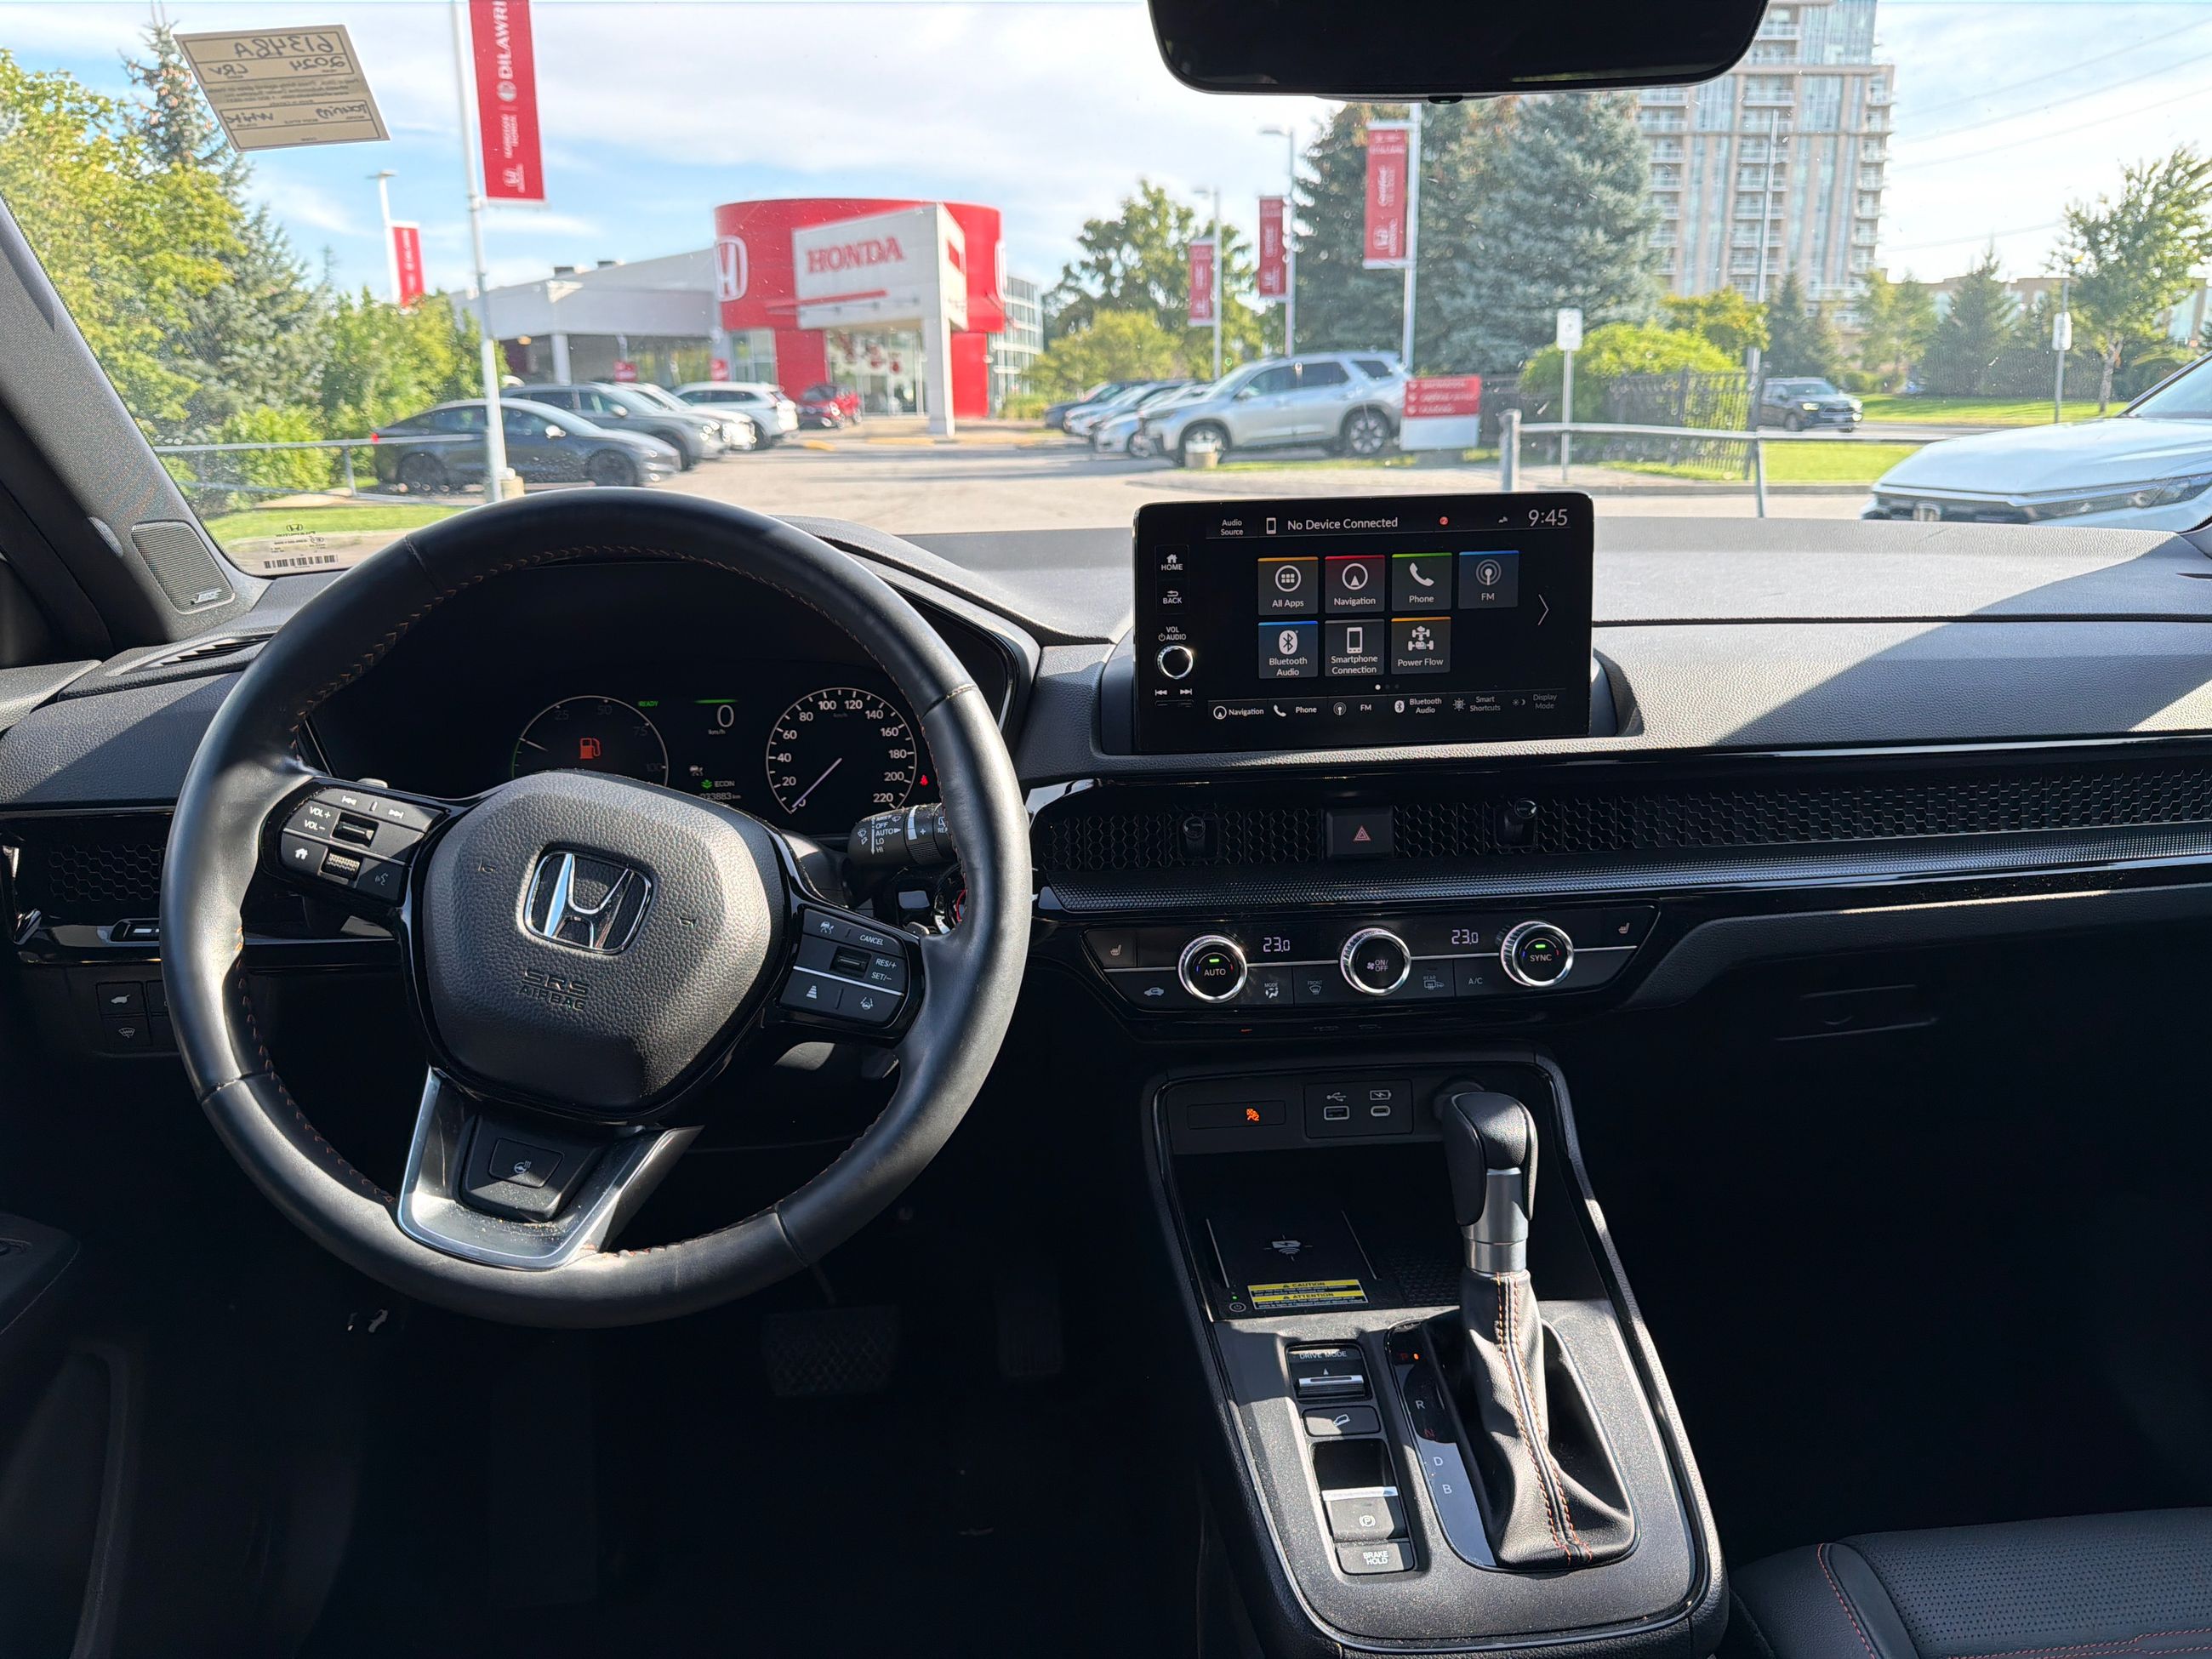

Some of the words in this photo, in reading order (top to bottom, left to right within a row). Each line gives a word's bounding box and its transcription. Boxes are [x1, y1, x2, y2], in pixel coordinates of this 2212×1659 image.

[806, 237, 904, 274] HONDA
[1528, 509, 1568, 527] 9:45
[1287, 520, 1303, 530] No
[1310, 520, 1341, 530] Device
[1343, 517, 1398, 529] Connected
[1272, 599, 1283, 607] All
[1284, 599, 1304, 609] Apps
[1334, 597, 1376, 607] Navigation
[1268, 657, 1308, 666] Bluetooth
[1331, 655, 1378, 665] Smartphone
[1398, 658, 1422, 667] Power
[1424, 658, 1444, 666] Flow
[1276, 668, 1300, 676] Audio
[1331, 666, 1377, 675] Connection
[1475, 695, 1495, 704] Smart
[1532, 693, 1558, 703] Display
[818, 700, 837, 710] 100
[844, 699, 864, 710] 120
[1295, 705, 1317, 714] Phone
[1360, 704, 1372, 712] FM
[1416, 705, 1436, 714] Audio
[1469, 704, 1501, 712] Shortcuts
[716, 704, 735, 728] 0
[799, 711, 814, 721] 80
[864, 710, 884, 720] 140
[1229, 708, 1264, 717] Navigation
[783, 730, 797, 740] 60
[880, 727, 899, 737] 160
[777, 753, 792, 762] 40
[888, 749, 908, 759] 180
[782, 776, 796, 786] 20
[883, 772, 904, 782] 200
[873, 793, 893, 803] 220
[875, 828, 894, 837] AUTO
[859, 934, 884, 945] CANCEL
[1451, 928, 1479, 945] 23.0
[1263, 937, 1291, 953] 23.0
[1204, 968, 1226, 977] AUTO
[523, 970, 590, 995] SRS
[1468, 978, 1483, 986] A/C
[517, 985, 585, 1012] AIRBAG
[1415, 1400, 1426, 1410] R
[1434, 1457, 1444, 1467] D
[1443, 1484, 1452, 1495] B
[1362, 1550, 1389, 1559] BRAKE
[1365, 1557, 1388, 1565] HOLD
